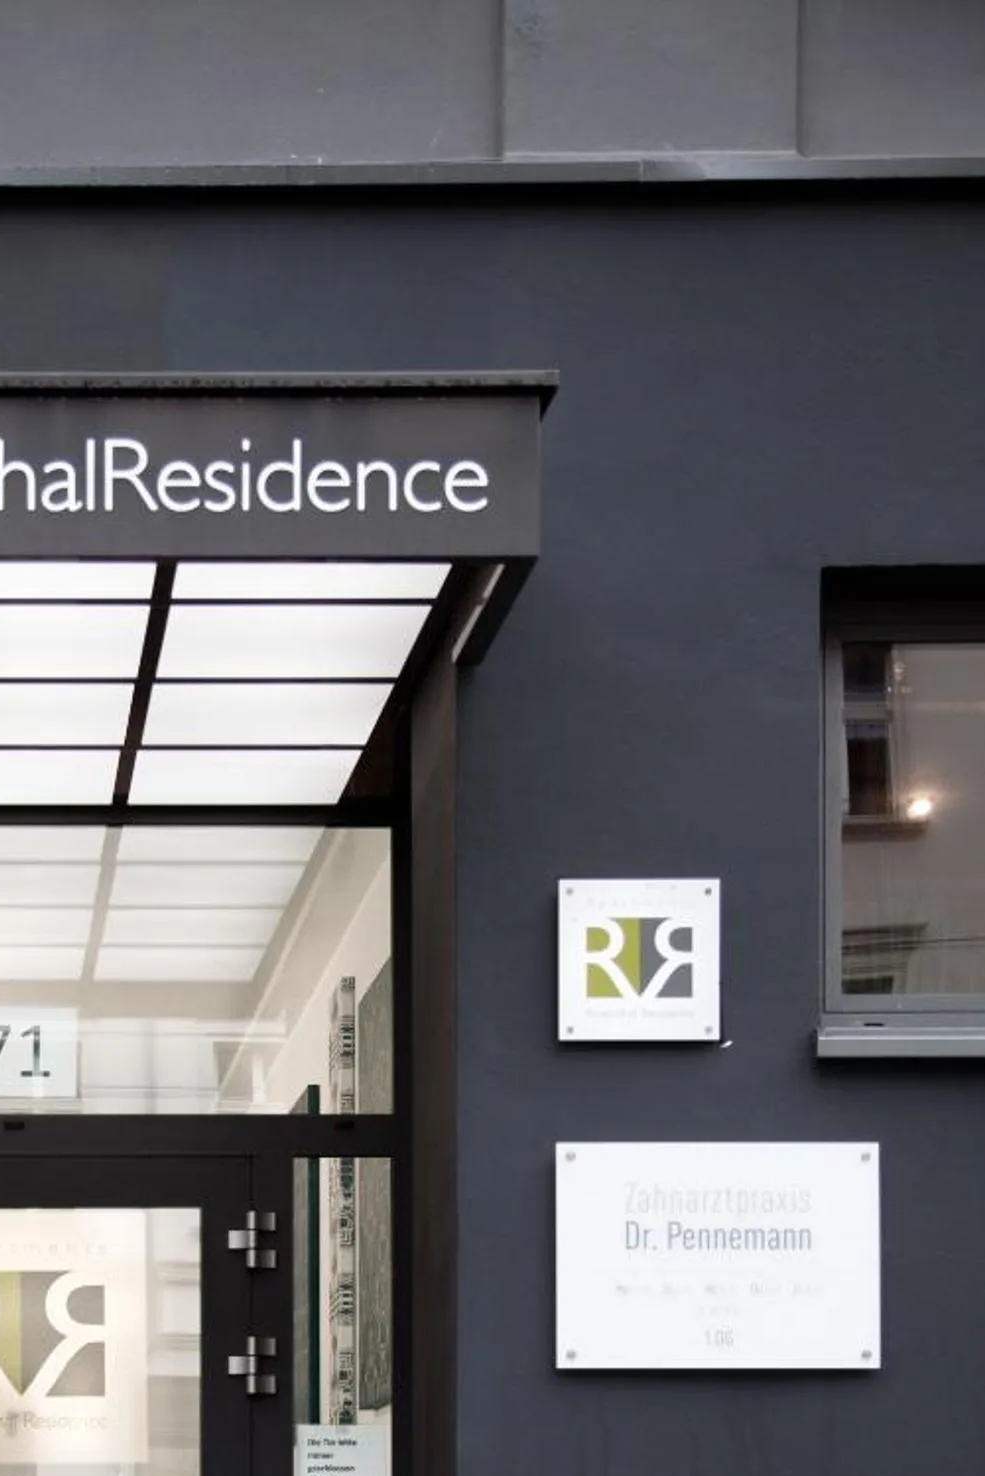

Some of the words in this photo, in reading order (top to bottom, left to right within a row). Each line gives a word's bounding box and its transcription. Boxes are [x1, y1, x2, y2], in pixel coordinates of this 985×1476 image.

[624, 1181, 813, 1219] Zahnarztpraxis
[625, 1220, 658, 1251] Dr.
[667, 1220, 813, 1251] Pennemann
